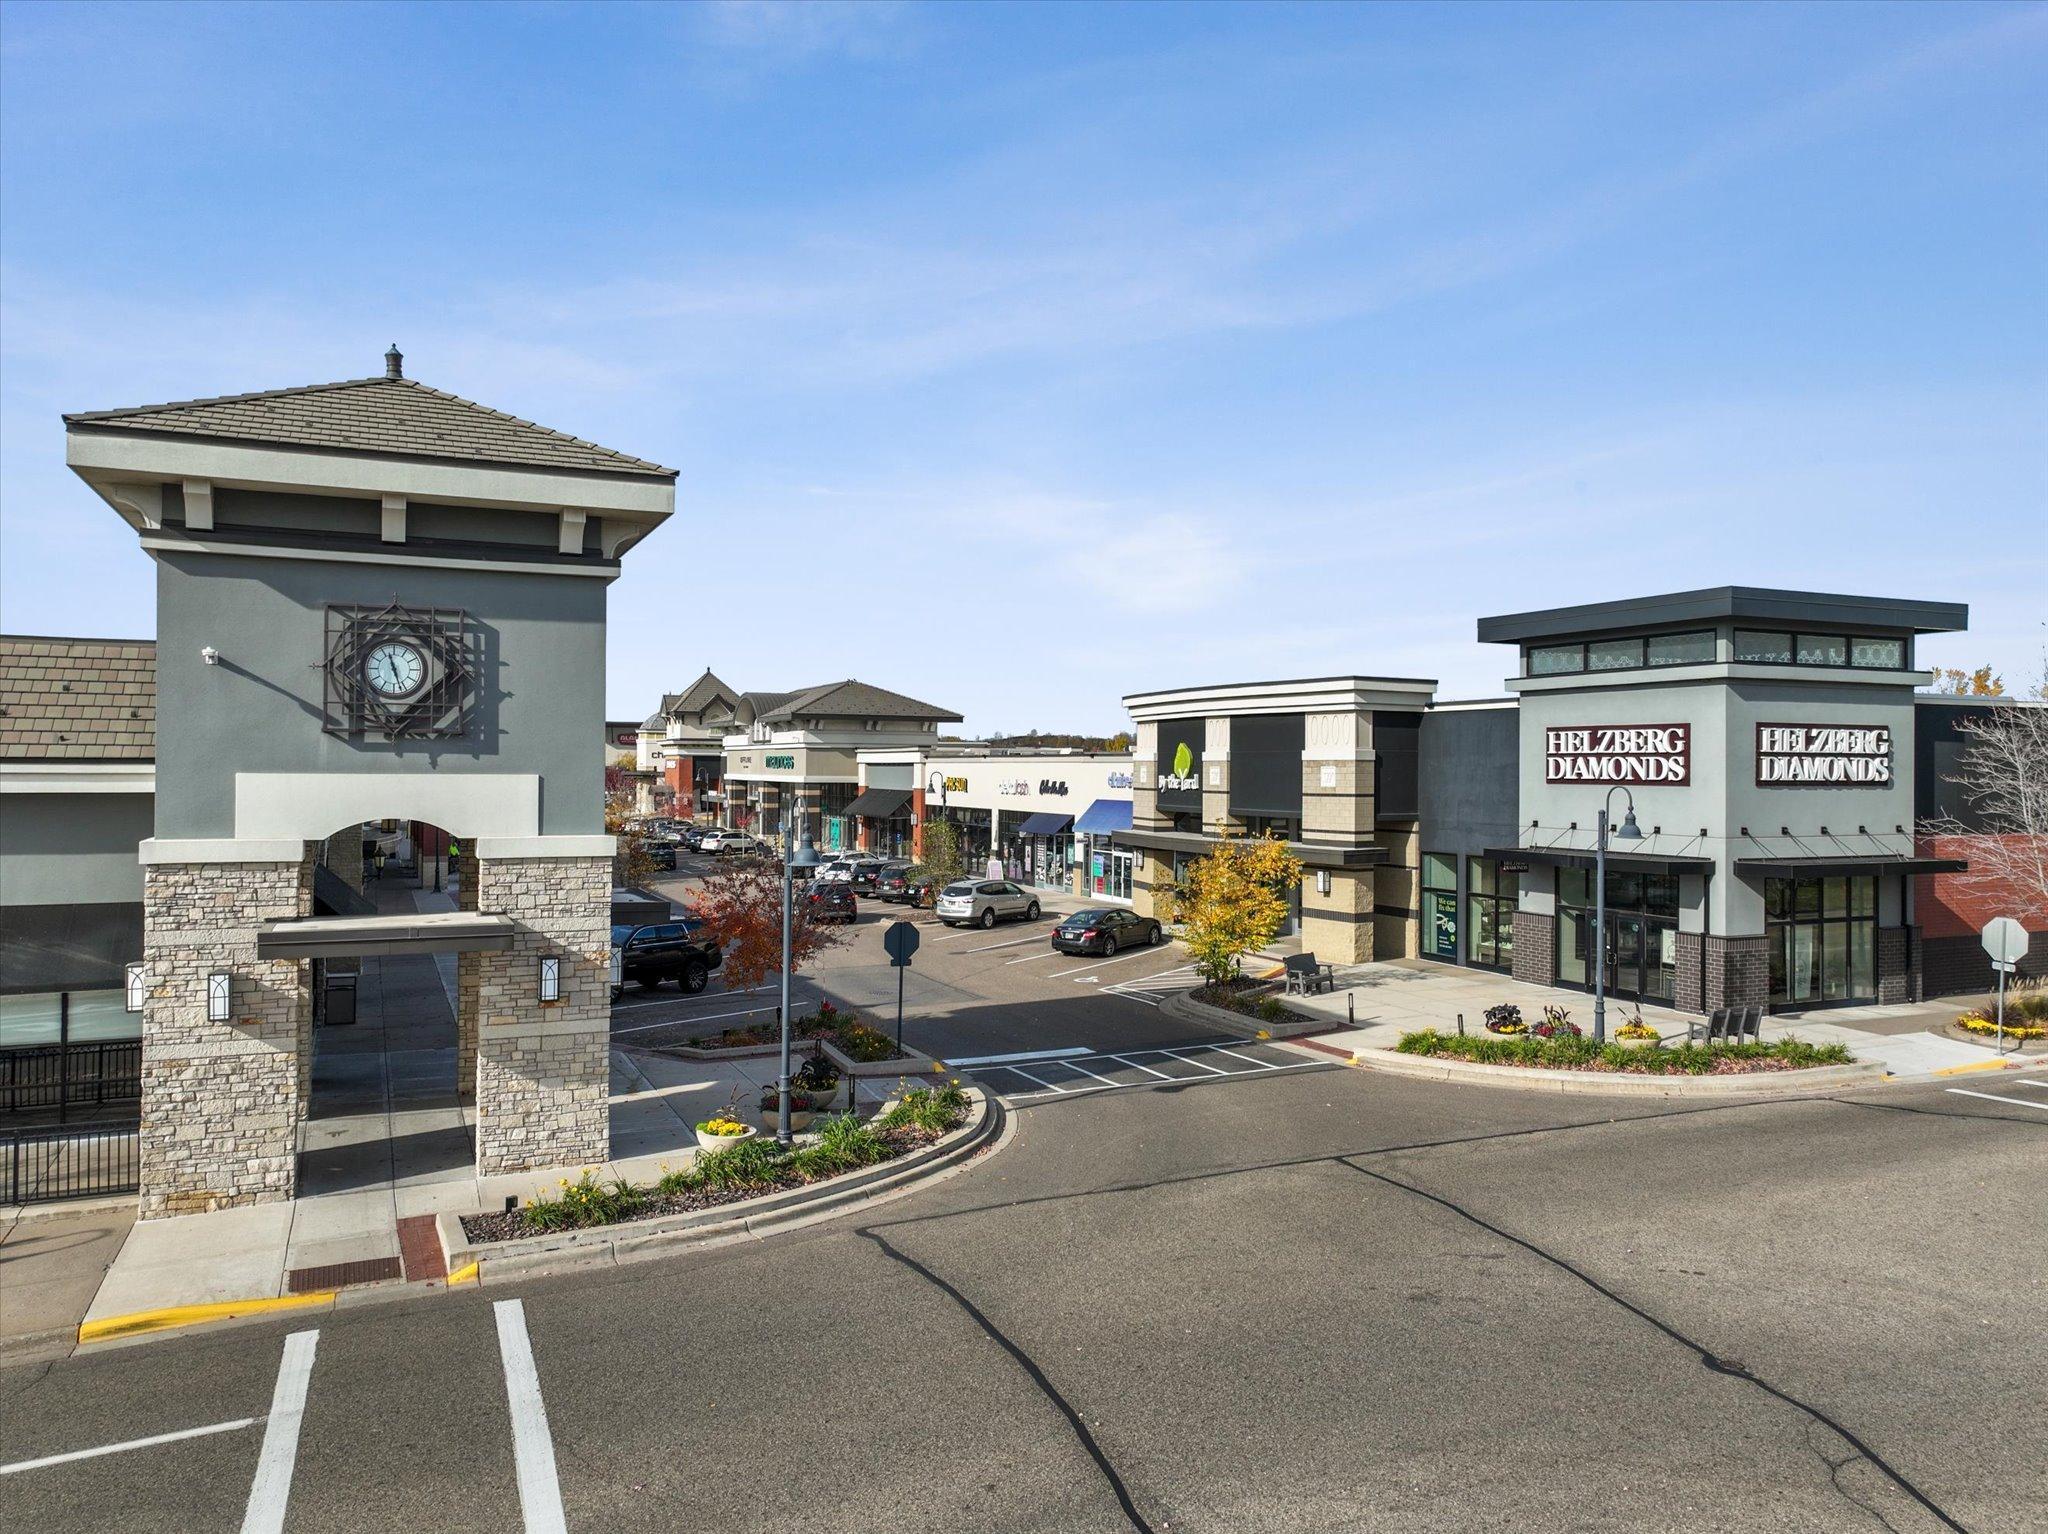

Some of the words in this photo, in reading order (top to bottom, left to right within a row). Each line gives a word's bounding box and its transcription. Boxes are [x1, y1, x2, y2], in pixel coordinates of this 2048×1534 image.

[1547, 728, 1686, 754] HELZBERG
[1760, 727, 1889, 754] HELZBERG
[1547, 756, 1686, 781] DIAMONDS
[1760, 756, 1890, 781] DIAMONDS
